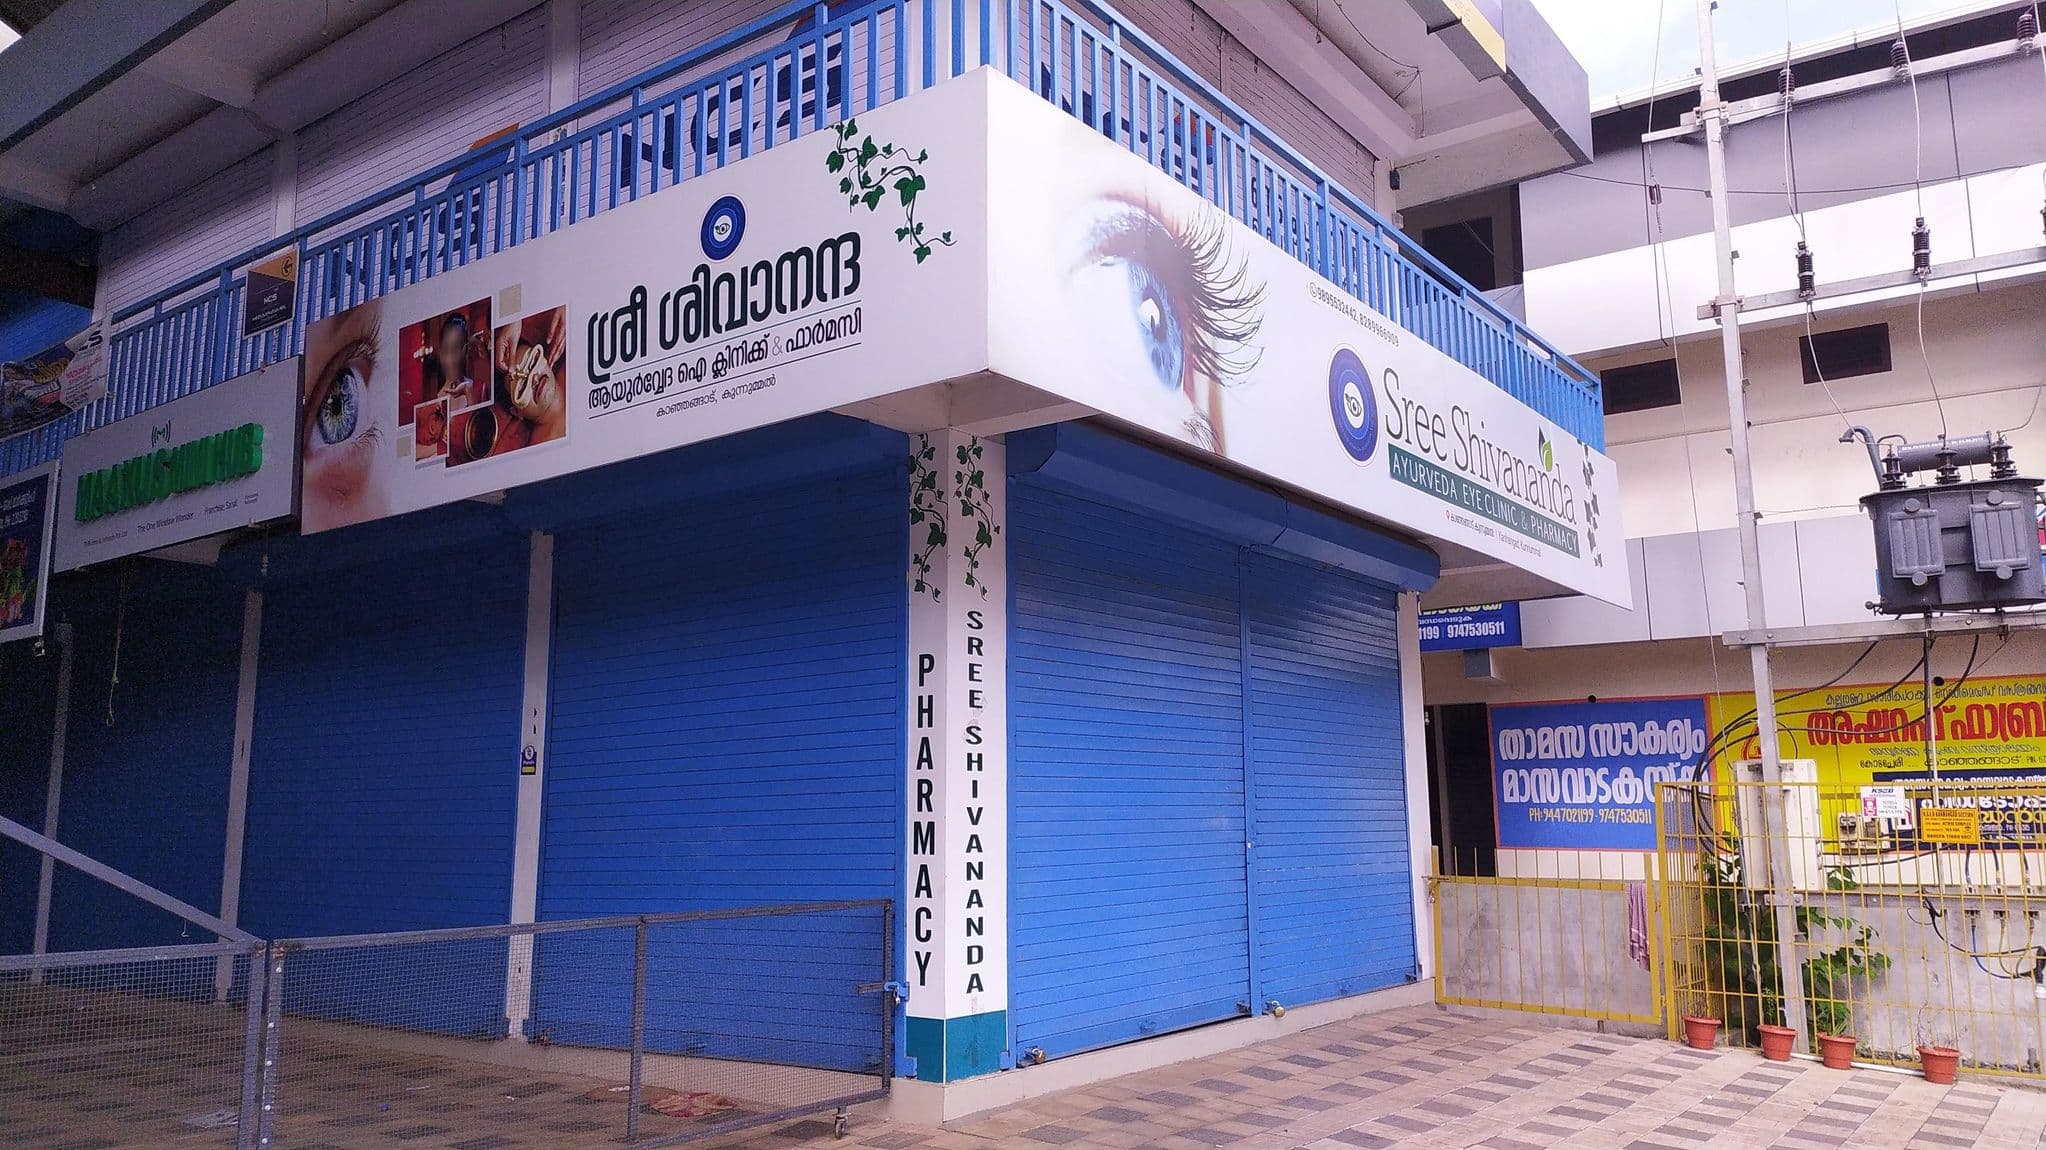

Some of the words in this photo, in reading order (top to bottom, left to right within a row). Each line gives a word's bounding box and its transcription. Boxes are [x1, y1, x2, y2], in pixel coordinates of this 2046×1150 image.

[588, 285, 647, 384] ശ്രീ
[659, 231, 861, 350] ശിവാനന്ദ
[678, 358, 707, 384] ഐ
[712, 332, 770, 379] ക്ലിനിക്ക്
[772, 336, 784, 357] &
[785, 306, 862, 353] ഫാർമസി
[1383, 367, 1447, 461] Sree
[1451, 405, 1577, 525] Shivananda
[1392, 451, 1457, 498] AYURVEDA
[1463, 483, 1484, 510] EYE
[1485, 494, 1518, 527] CLINIC
[1520, 511, 1529, 531] &
[1530, 517, 1578, 552] PHARMACY
[966, 610, 984, 709] SREE
[1447, 621, 1505, 639] 9747530511
[1499, 724, 1585, 760] താമസ
[913, 653, 936, 987] PHARMACY
[966, 725, 984, 994] SHIVANANDA
[1598, 808, 1652, 824] 9747530511
